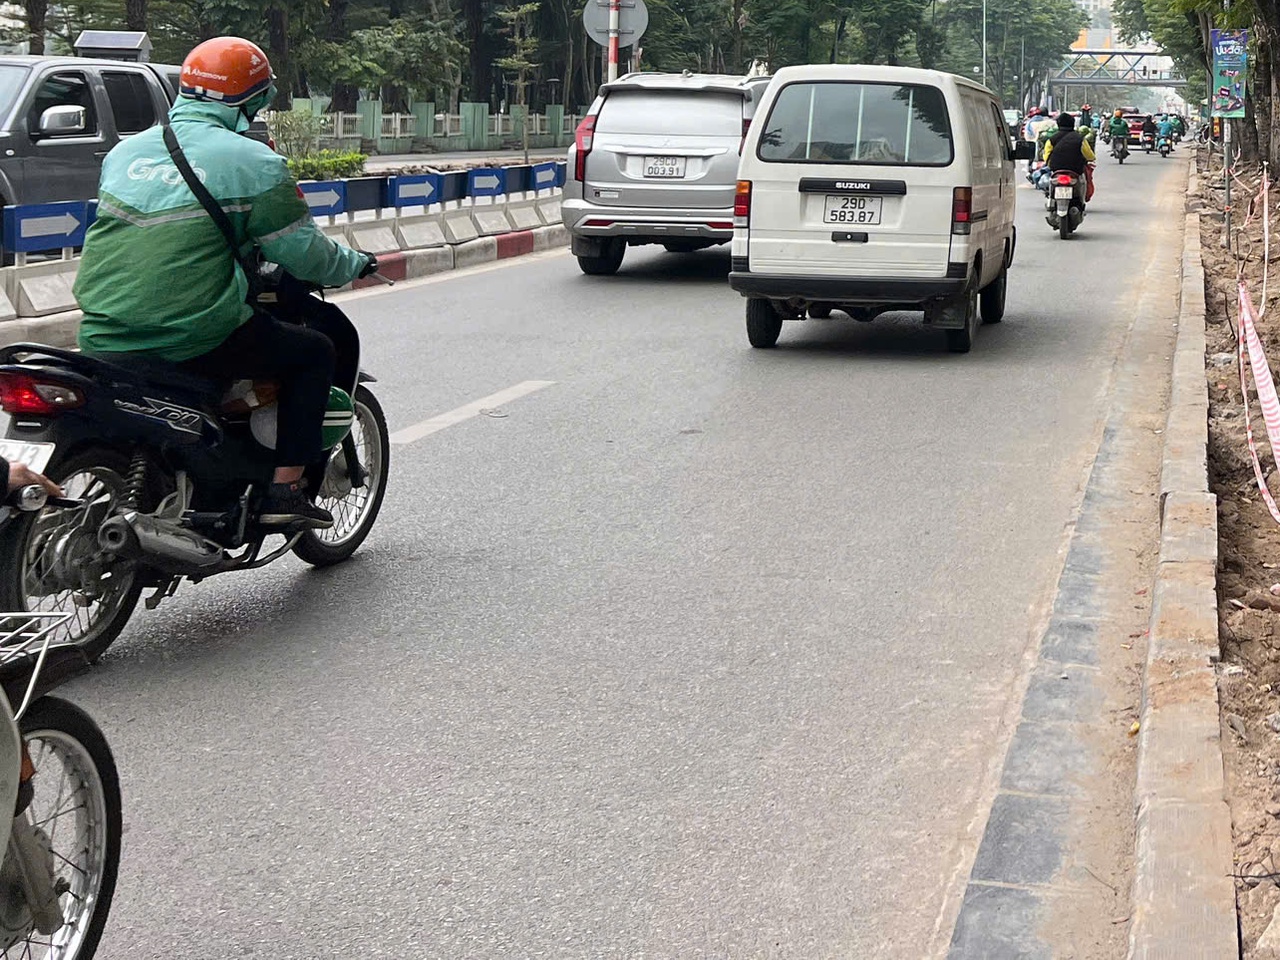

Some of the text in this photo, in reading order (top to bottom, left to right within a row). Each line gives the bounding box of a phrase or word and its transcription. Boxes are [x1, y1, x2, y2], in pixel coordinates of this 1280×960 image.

[647, 166, 680, 176] 003.91
[835, 182, 870, 190] SUZUKI
[841, 197, 866, 209] 29D
[830, 210, 875, 222] 583.87
